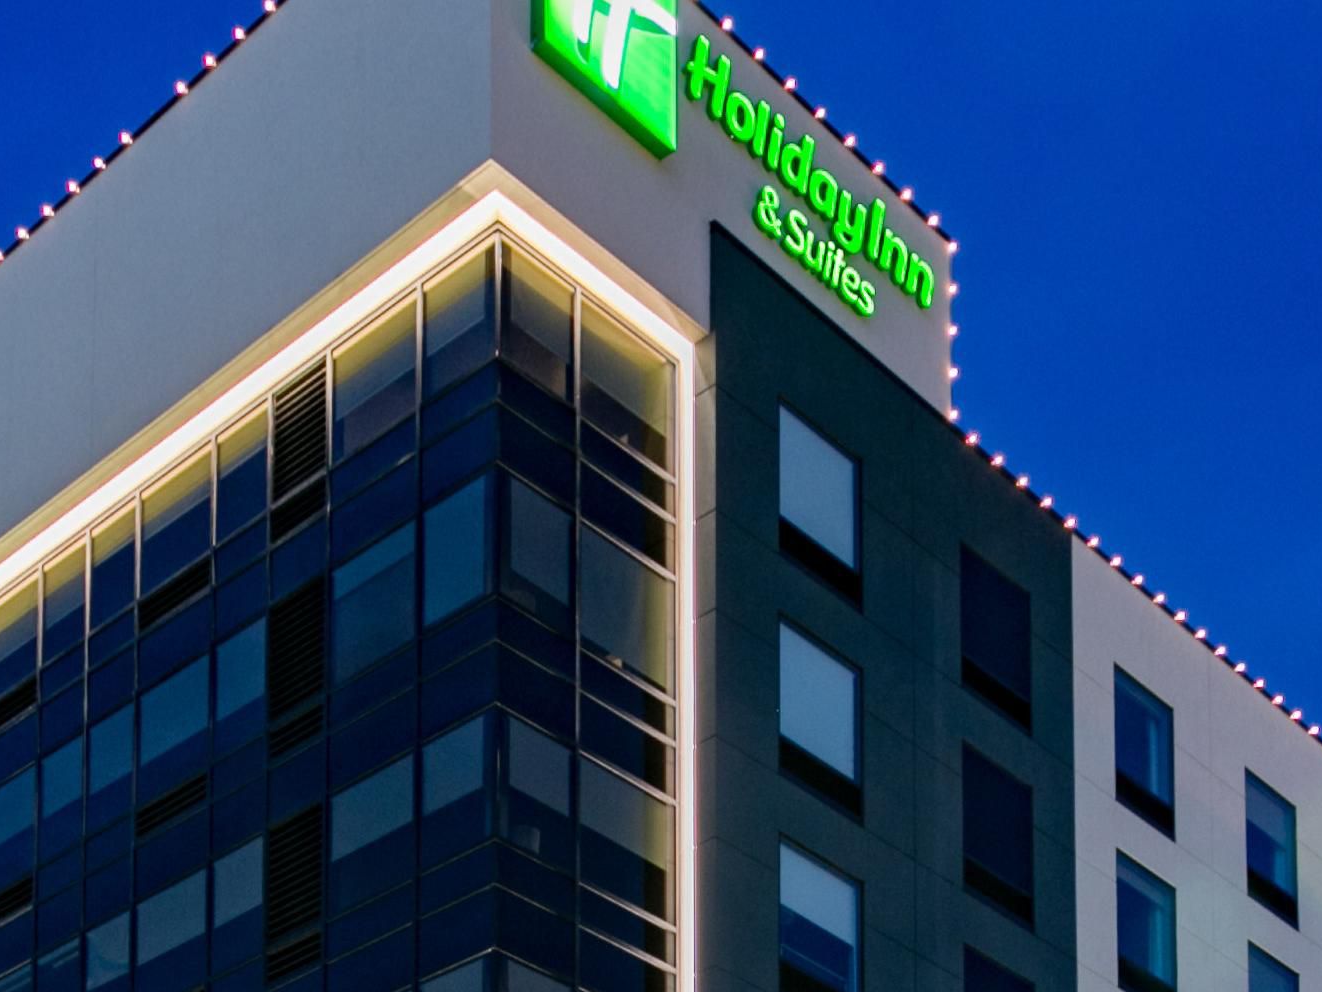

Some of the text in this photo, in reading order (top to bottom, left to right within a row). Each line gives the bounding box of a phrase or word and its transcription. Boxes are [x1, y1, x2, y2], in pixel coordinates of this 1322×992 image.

[684, 33, 866, 254] Holiday
[866, 197, 935, 308] Inn
[752, 185, 877, 317] & Suites
